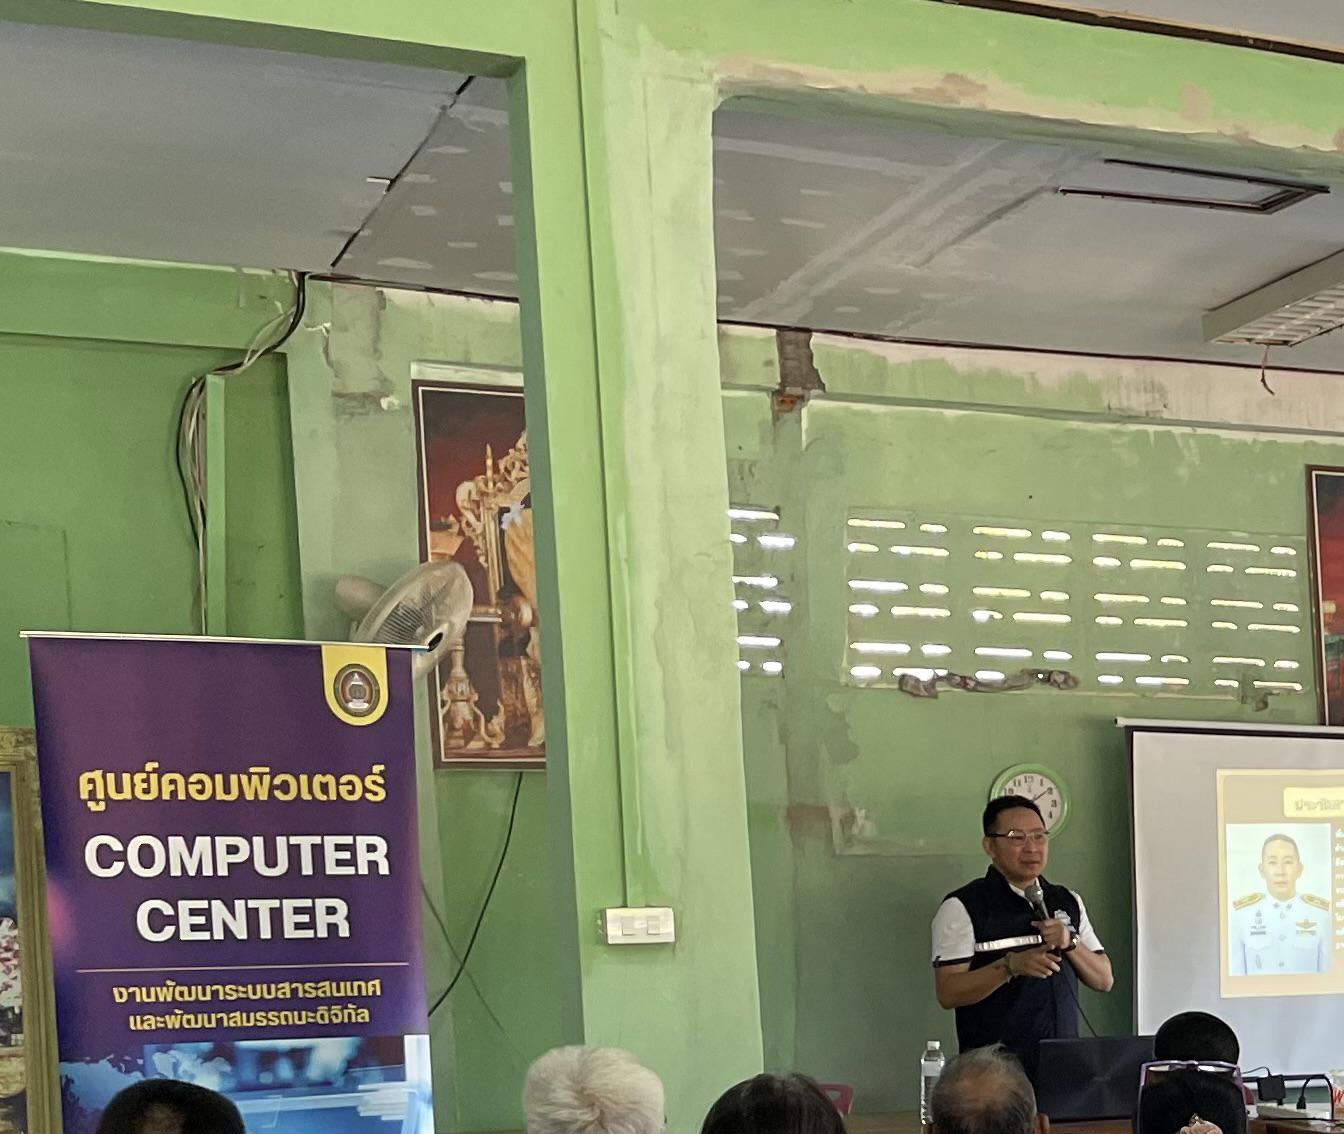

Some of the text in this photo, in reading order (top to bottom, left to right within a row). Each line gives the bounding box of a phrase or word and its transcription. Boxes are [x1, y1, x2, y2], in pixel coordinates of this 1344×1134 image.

[79, 761, 388, 811] ศูนย์คอมพิวเตอร์
[84, 835, 391, 877] COMPUTER
[135, 898, 351, 942] CENTER
[112, 977, 382, 1006] งานพัฒนาระบบสารสนเทศ
[129, 1003, 370, 1032] และพัฒนาสมรรถนะดิจิทัล
